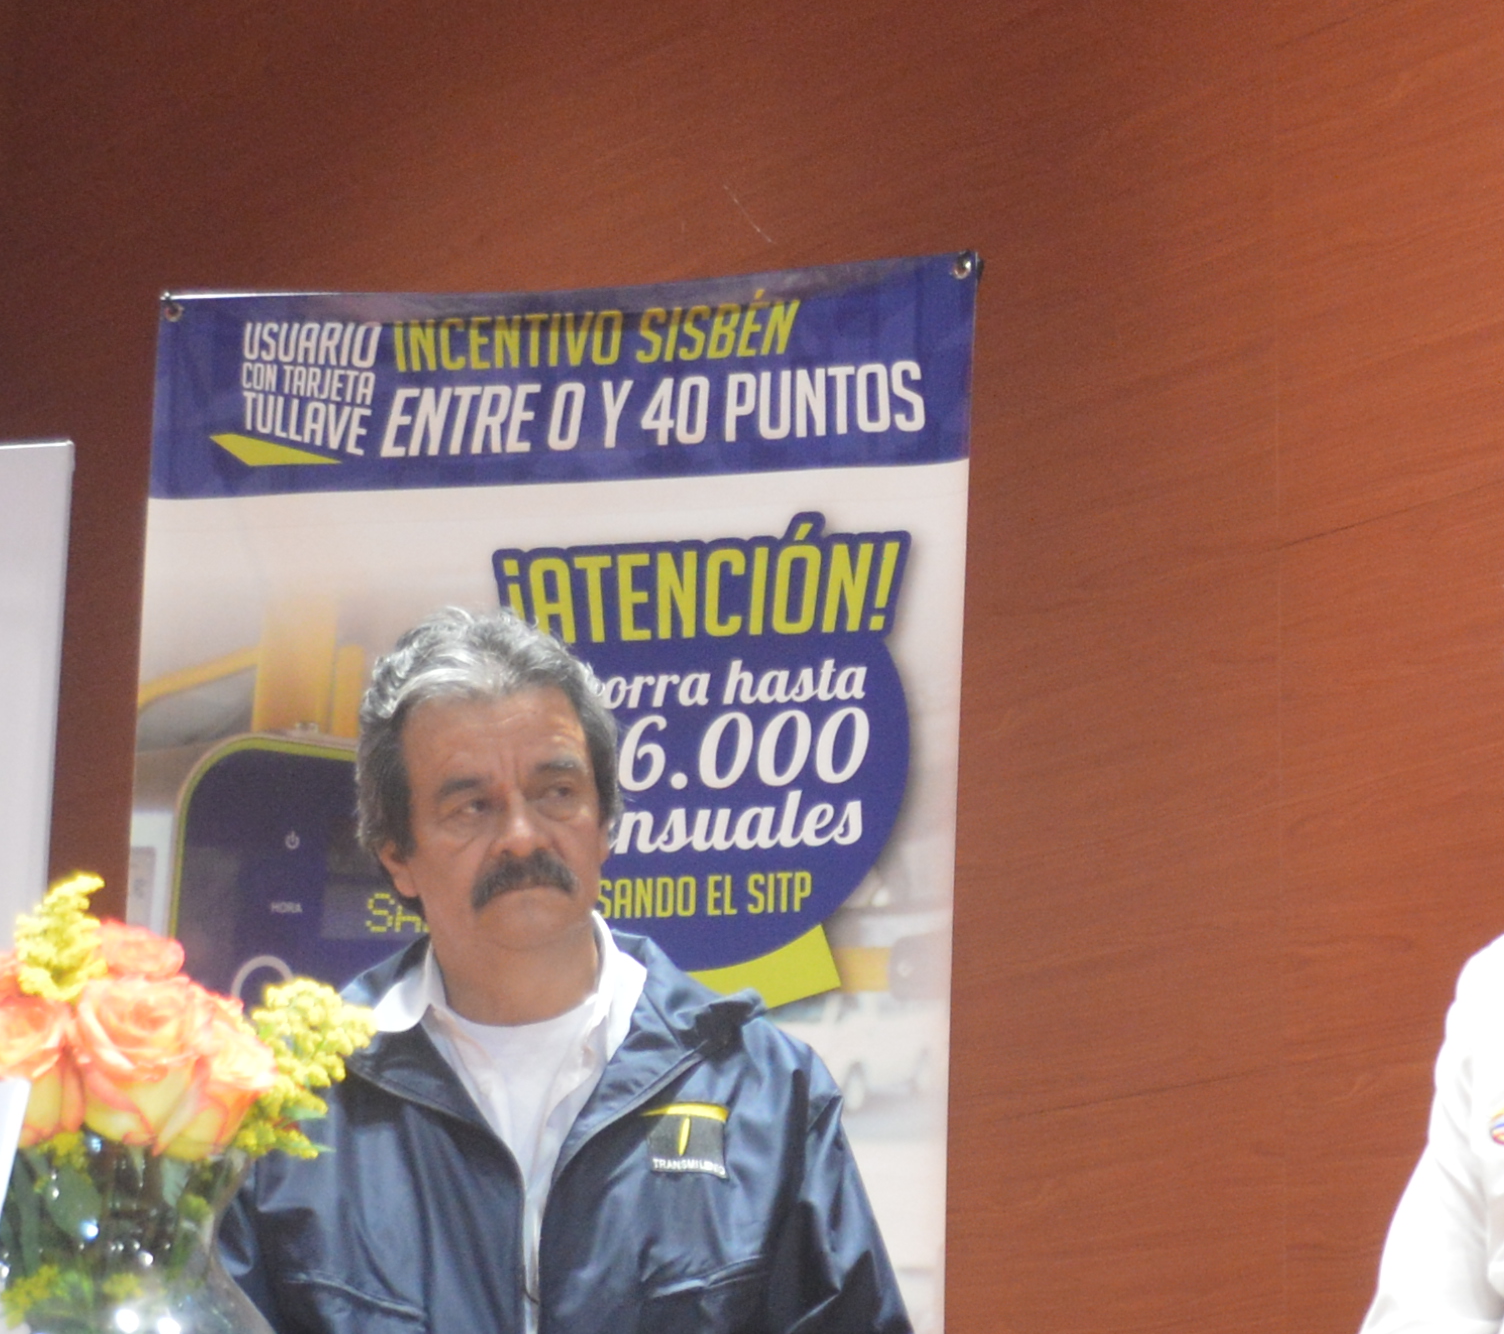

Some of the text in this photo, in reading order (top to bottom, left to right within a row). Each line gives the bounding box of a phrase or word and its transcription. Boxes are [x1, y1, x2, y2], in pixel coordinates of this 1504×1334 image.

[243, 321, 383, 368] USUARIO
[394, 288, 800, 372] INCENTIVO SISBÉN
[242, 362, 376, 406] CON TARJETA
[380, 384, 541, 457] ENTRE
[601, 379, 634, 449] Y
[640, 375, 710, 446] 40
[724, 360, 926, 442] PUNTOS
[242, 390, 372, 456] TULLAVE
[604, 659, 868, 709] orra hasta
[618, 706, 871, 793] 6.000
[608, 790, 864, 855] nsuales
[598, 872, 813, 919] SANDO EL SITP
